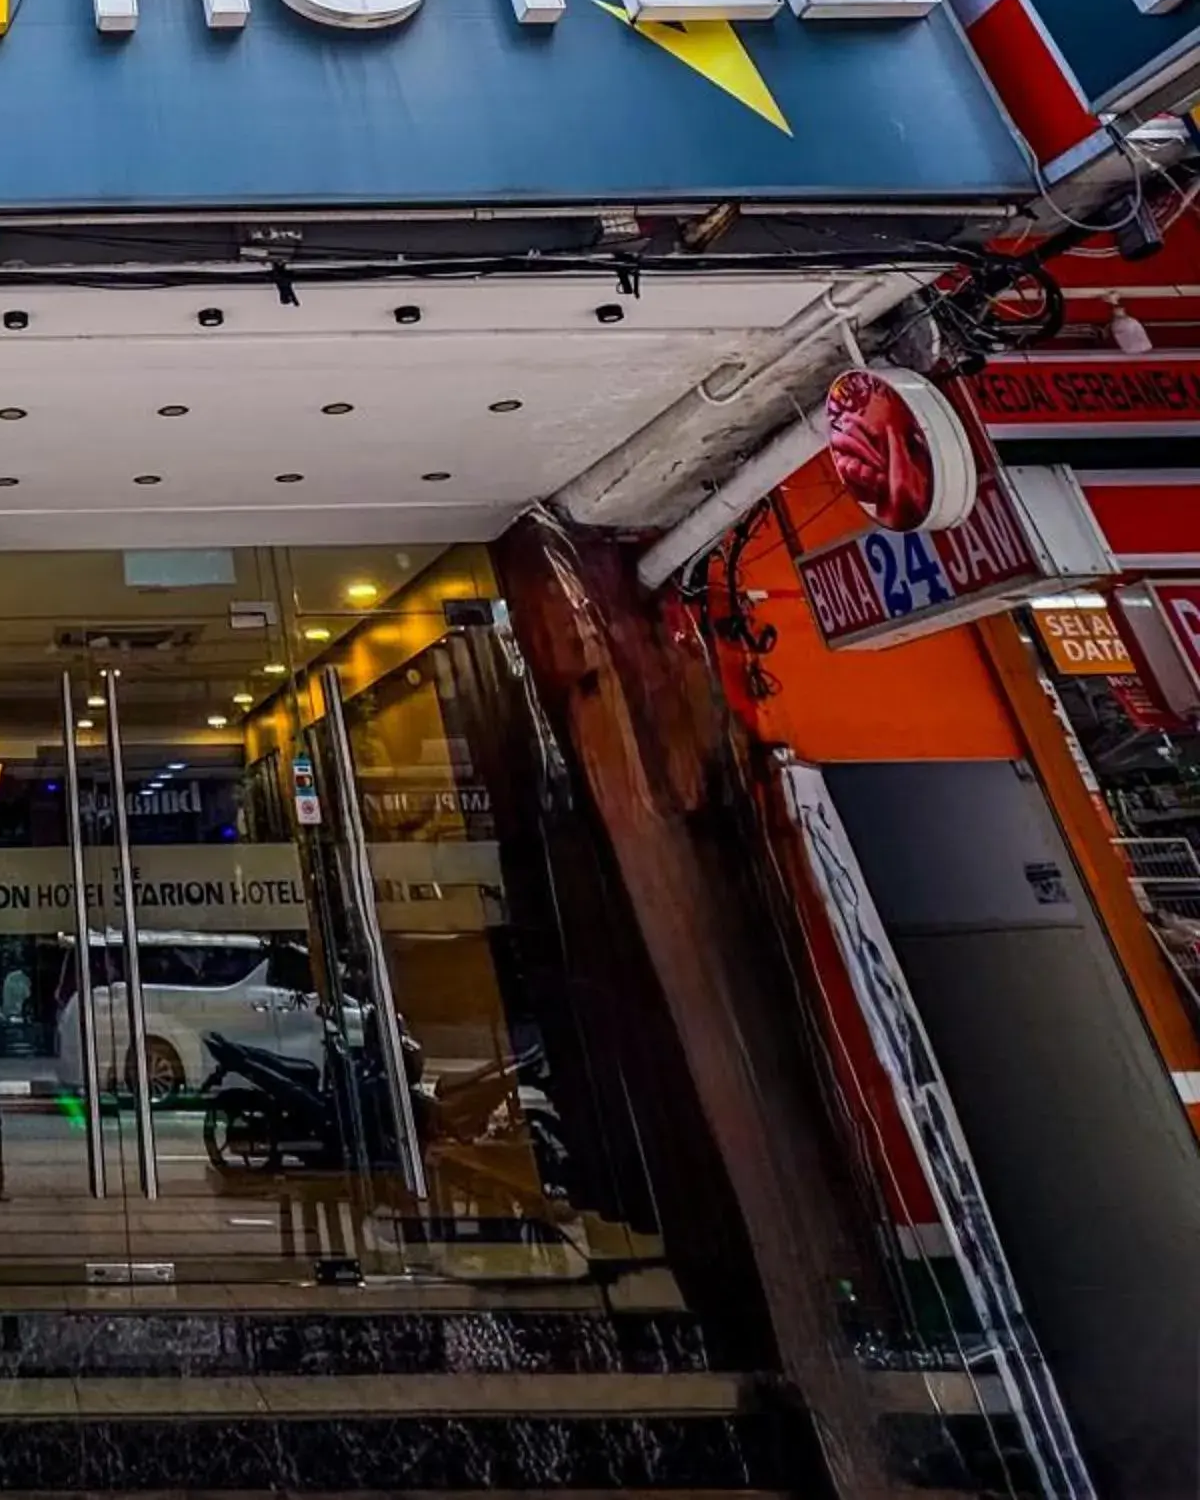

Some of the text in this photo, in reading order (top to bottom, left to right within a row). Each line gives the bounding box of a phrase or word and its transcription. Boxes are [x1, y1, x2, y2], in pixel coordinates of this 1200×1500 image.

[805, 489, 1029, 634] BUKA 24 JAM
[1061, 638, 1131, 662] DATA
[112, 866, 141, 880] TE
